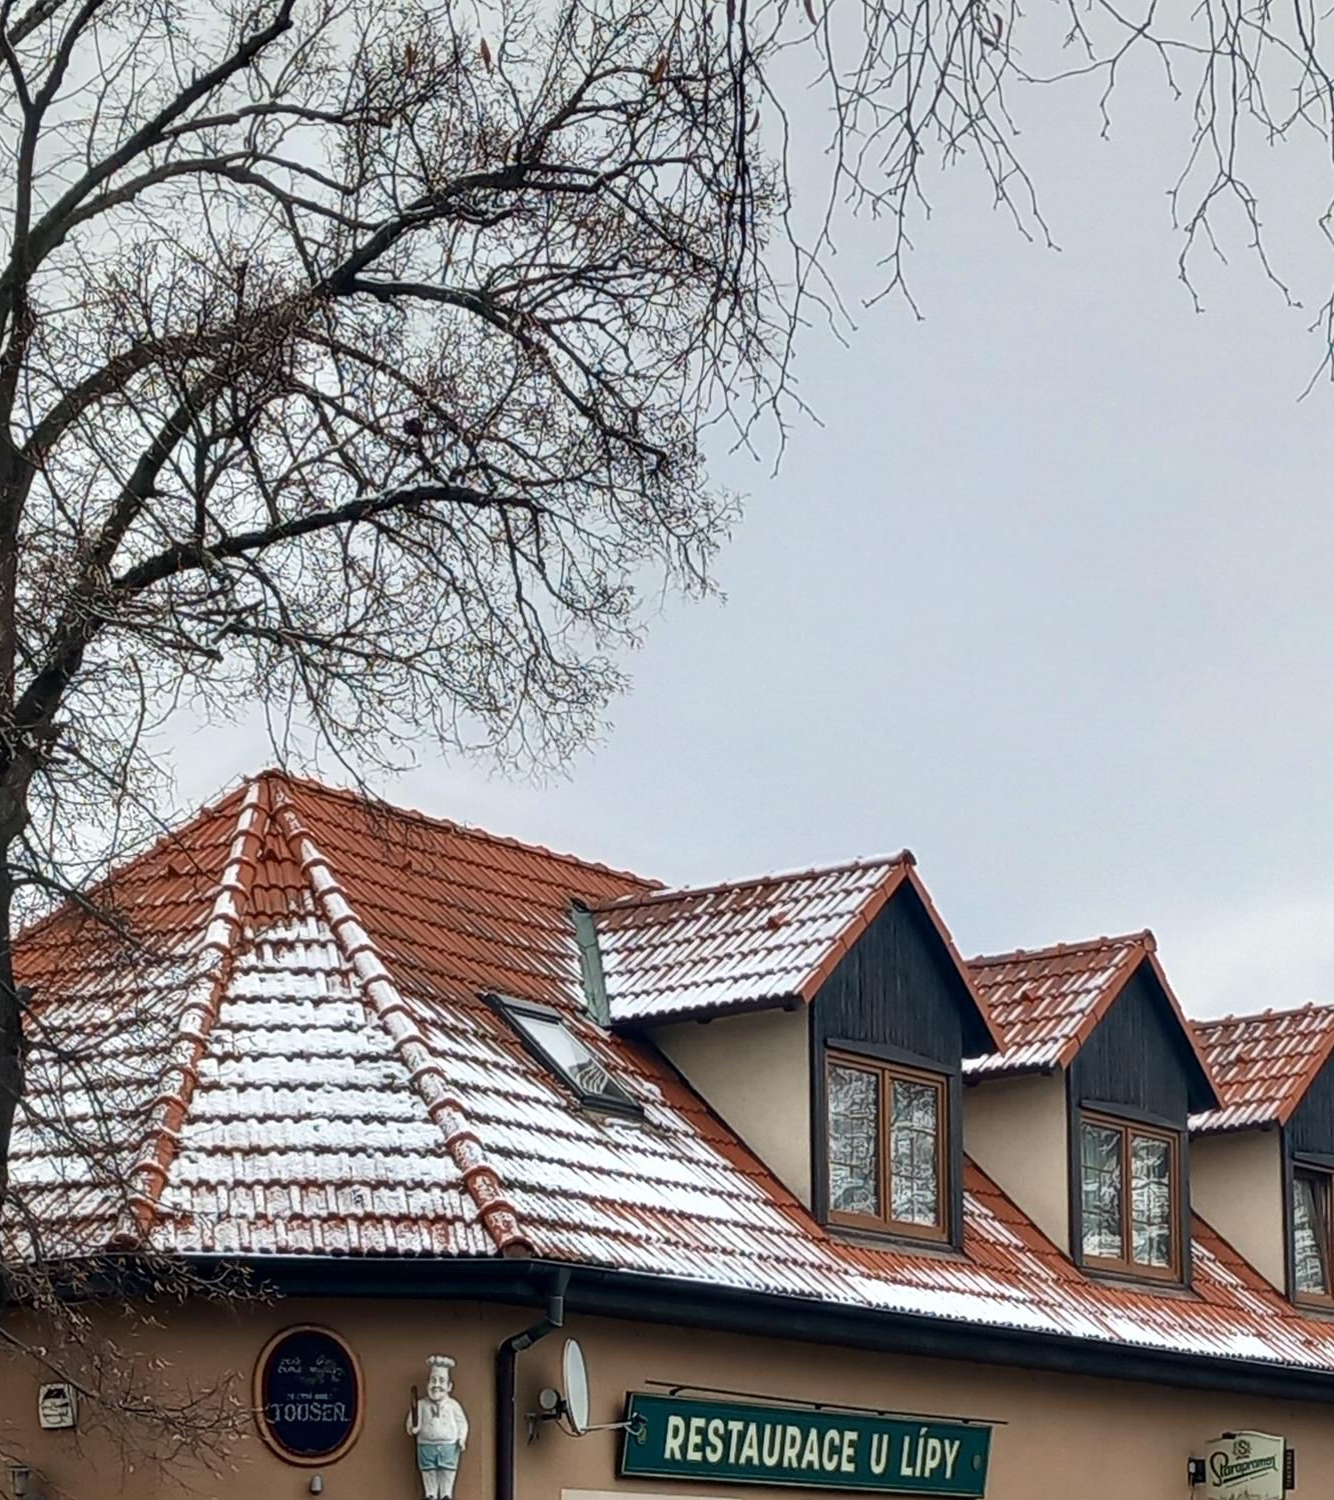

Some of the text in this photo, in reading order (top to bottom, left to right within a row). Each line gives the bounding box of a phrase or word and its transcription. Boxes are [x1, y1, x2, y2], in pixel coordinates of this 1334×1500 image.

[663, 1414, 961, 1480] RESTAURACE U LÍPY
[1210, 1451, 1279, 1487] Staropramen
